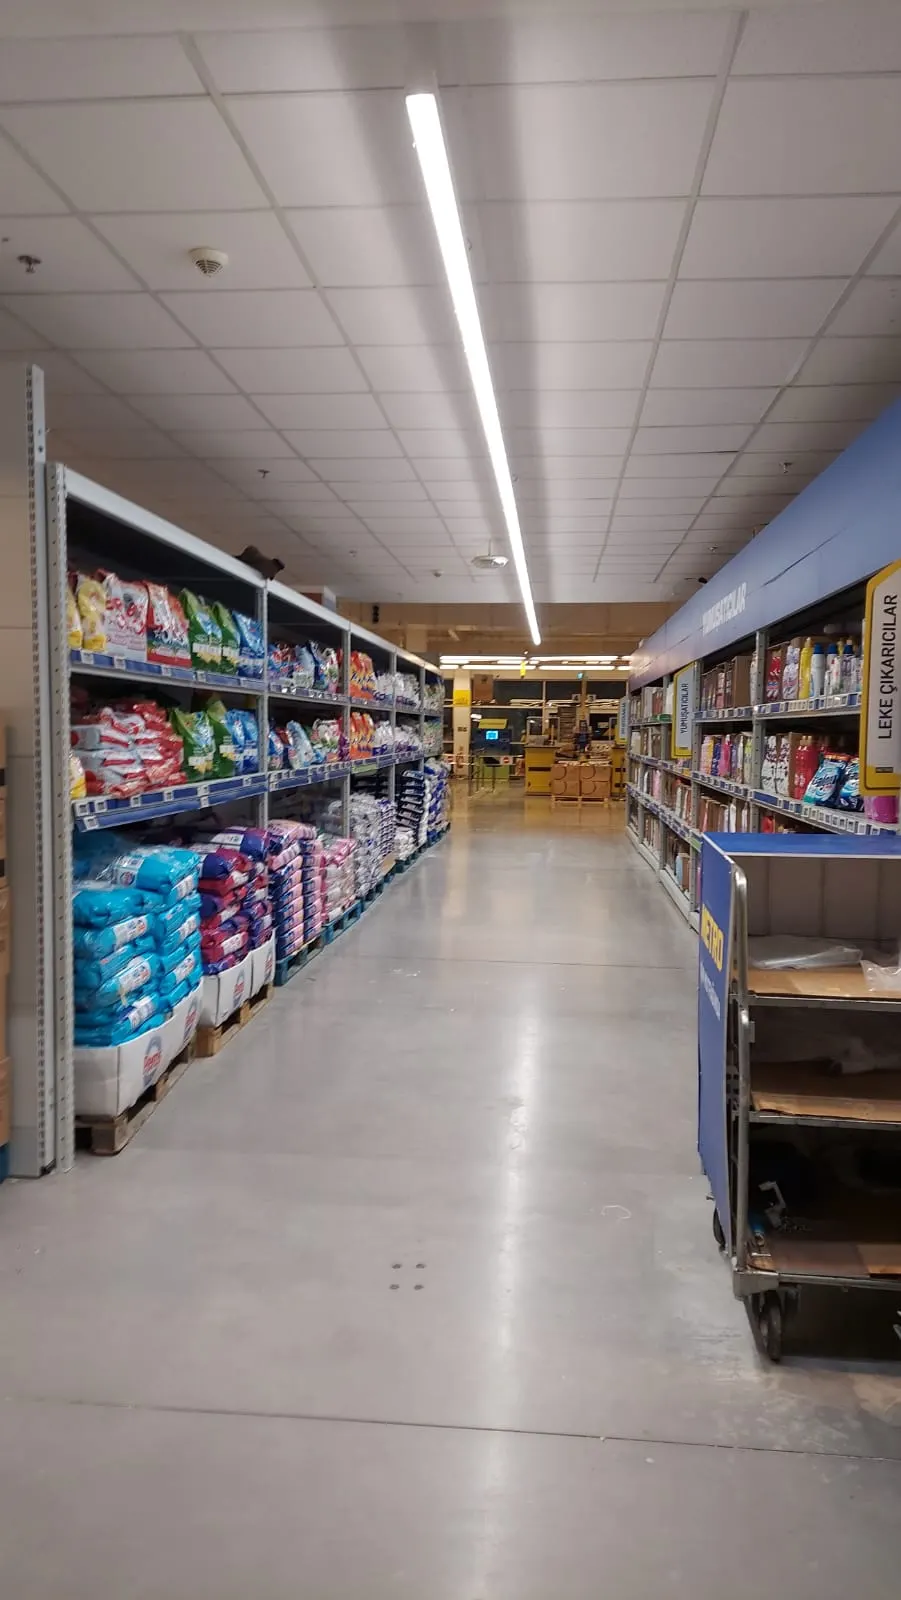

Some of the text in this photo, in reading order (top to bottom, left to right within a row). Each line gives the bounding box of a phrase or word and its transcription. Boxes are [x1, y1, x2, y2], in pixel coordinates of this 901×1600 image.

[878, 594, 898, 739] LEKE ÇIKARICILAR
[680, 683, 689, 734] YUMUŞATICILAR
[701, 903, 724, 972] METRO
